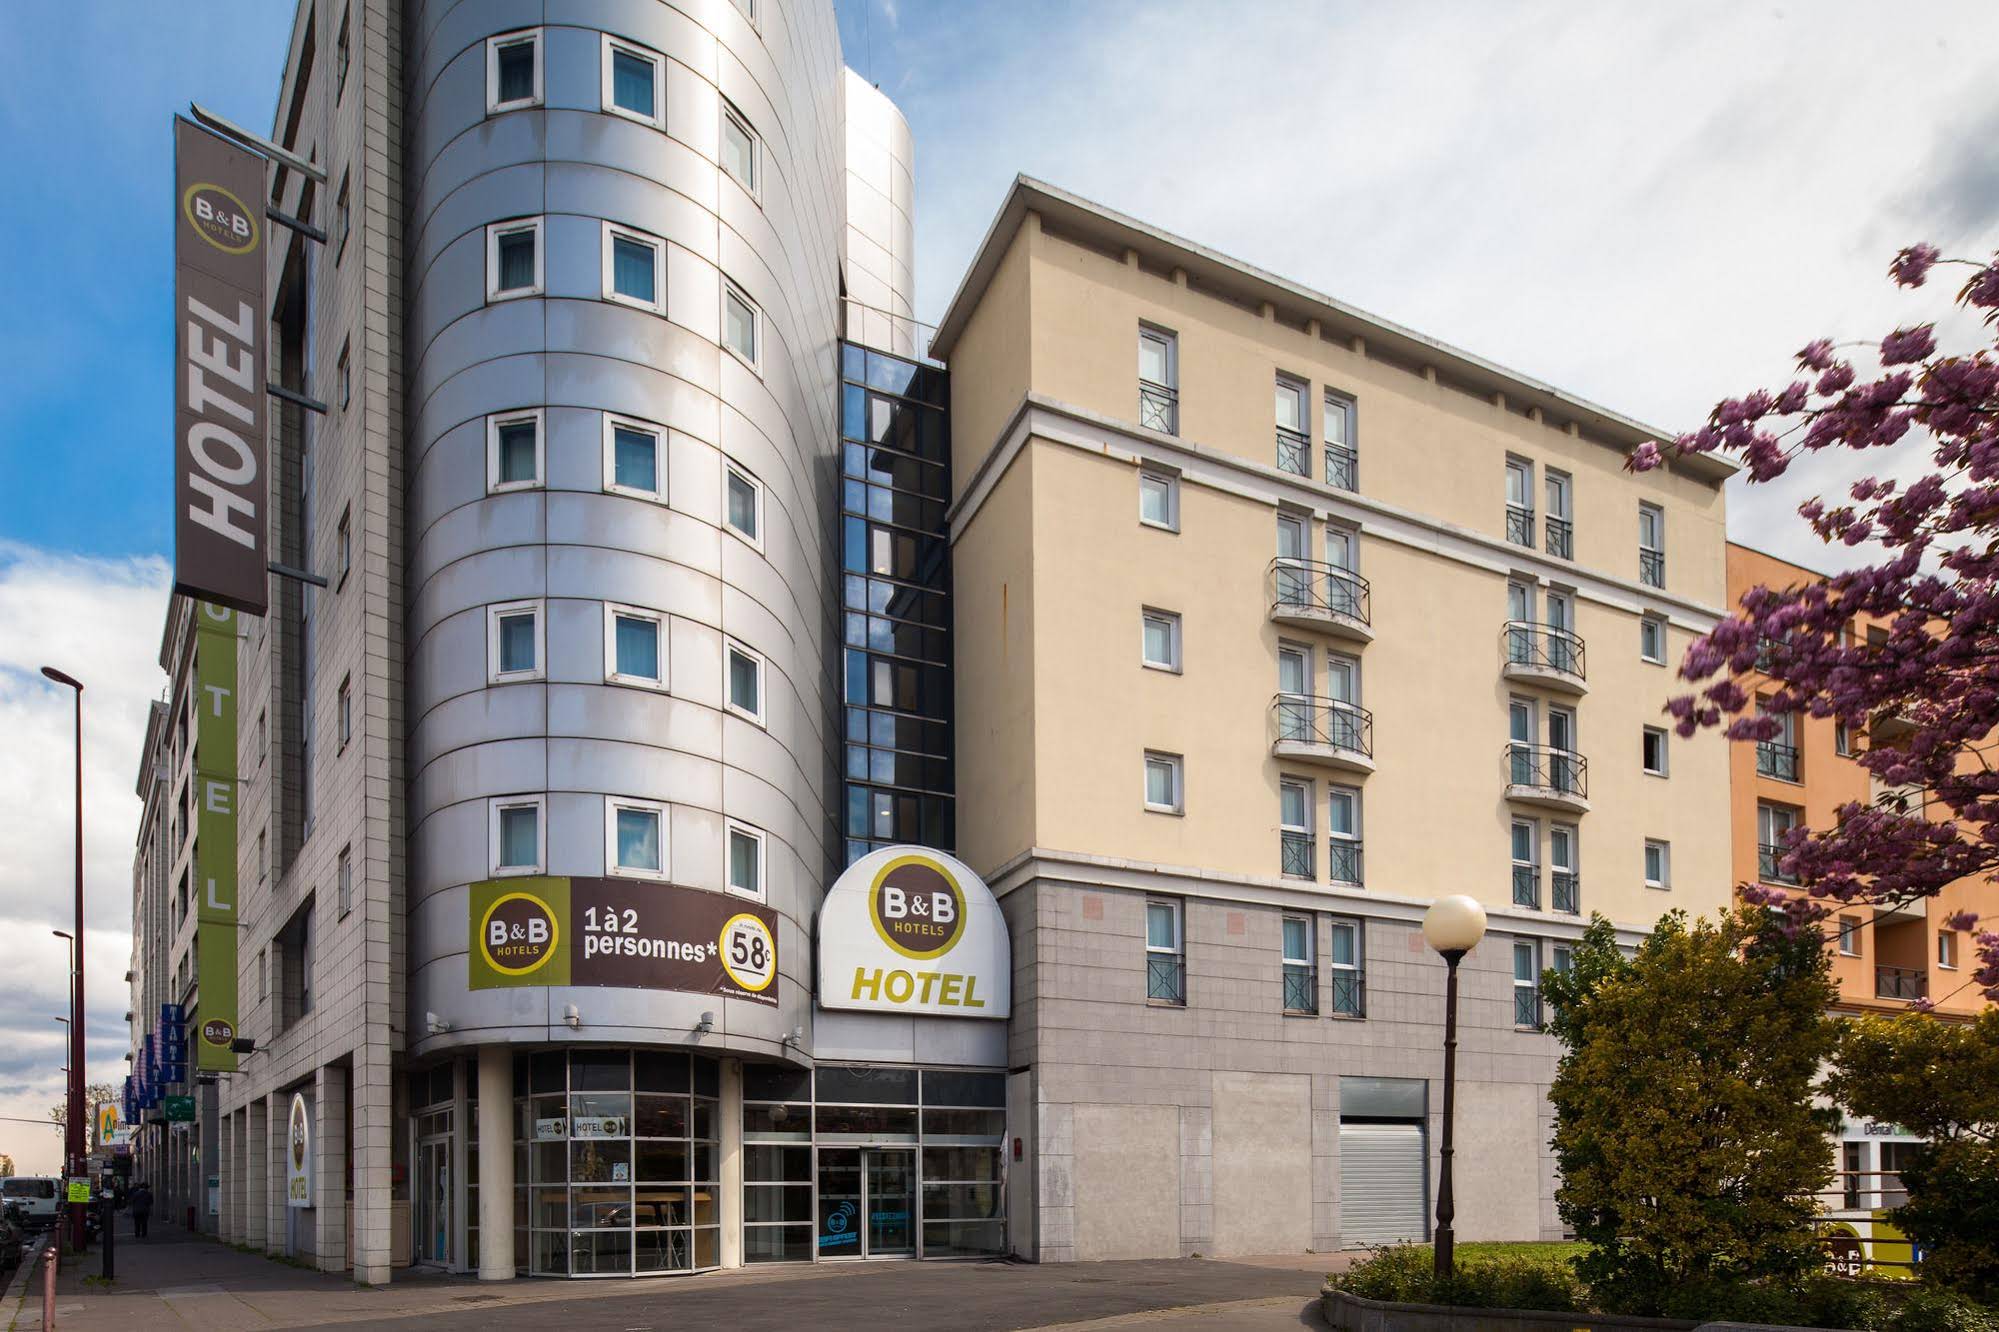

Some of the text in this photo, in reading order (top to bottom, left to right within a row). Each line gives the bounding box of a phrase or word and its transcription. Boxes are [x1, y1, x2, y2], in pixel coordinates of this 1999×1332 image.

[203, 221, 243, 243] HOTELS
[188, 295, 257, 551] HOTEL
[884, 886, 955, 923] B&B
[490, 917, 549, 945] B&B
[894, 921, 945, 936] HOTELS
[497, 945, 540, 956] HOTELS
[850, 967, 986, 1008] HOTEL
[169, 1006, 178, 1081] TATI
[537, 1125, 553, 1133] HOTEL
[576, 1123, 603, 1132] HOTEL
